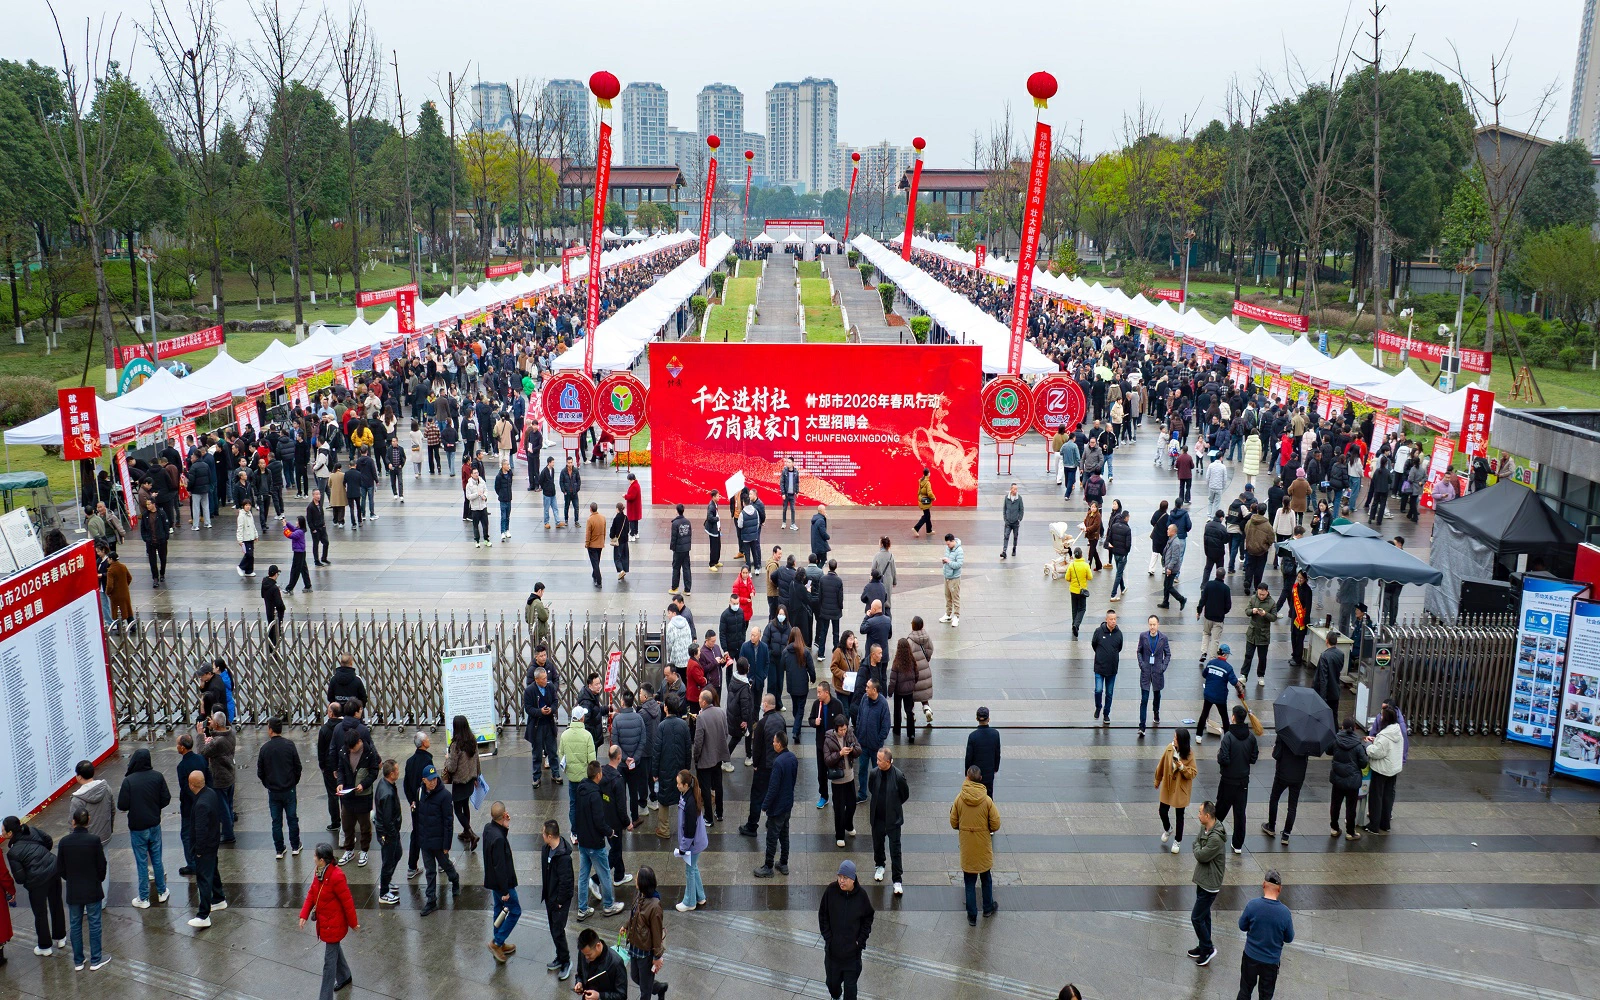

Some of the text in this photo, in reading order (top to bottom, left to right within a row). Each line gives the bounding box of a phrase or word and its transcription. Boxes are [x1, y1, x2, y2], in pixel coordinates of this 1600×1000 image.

[691, 385, 791, 414] 千企进村社
[805, 392, 941, 410] 什邡市2026年春风行动
[67, 393, 80, 436] 就业援助
[704, 413, 800, 442] 万岗敲家门
[805, 414, 869, 430] 大型招聘会
[1466, 393, 1480, 442] 高校毕业生
[80, 411, 93, 453] 招聘专区
[805, 433, 900, 443] CHUNFENGXINGDONG
[1473, 412, 1485, 452] 招聘专区
